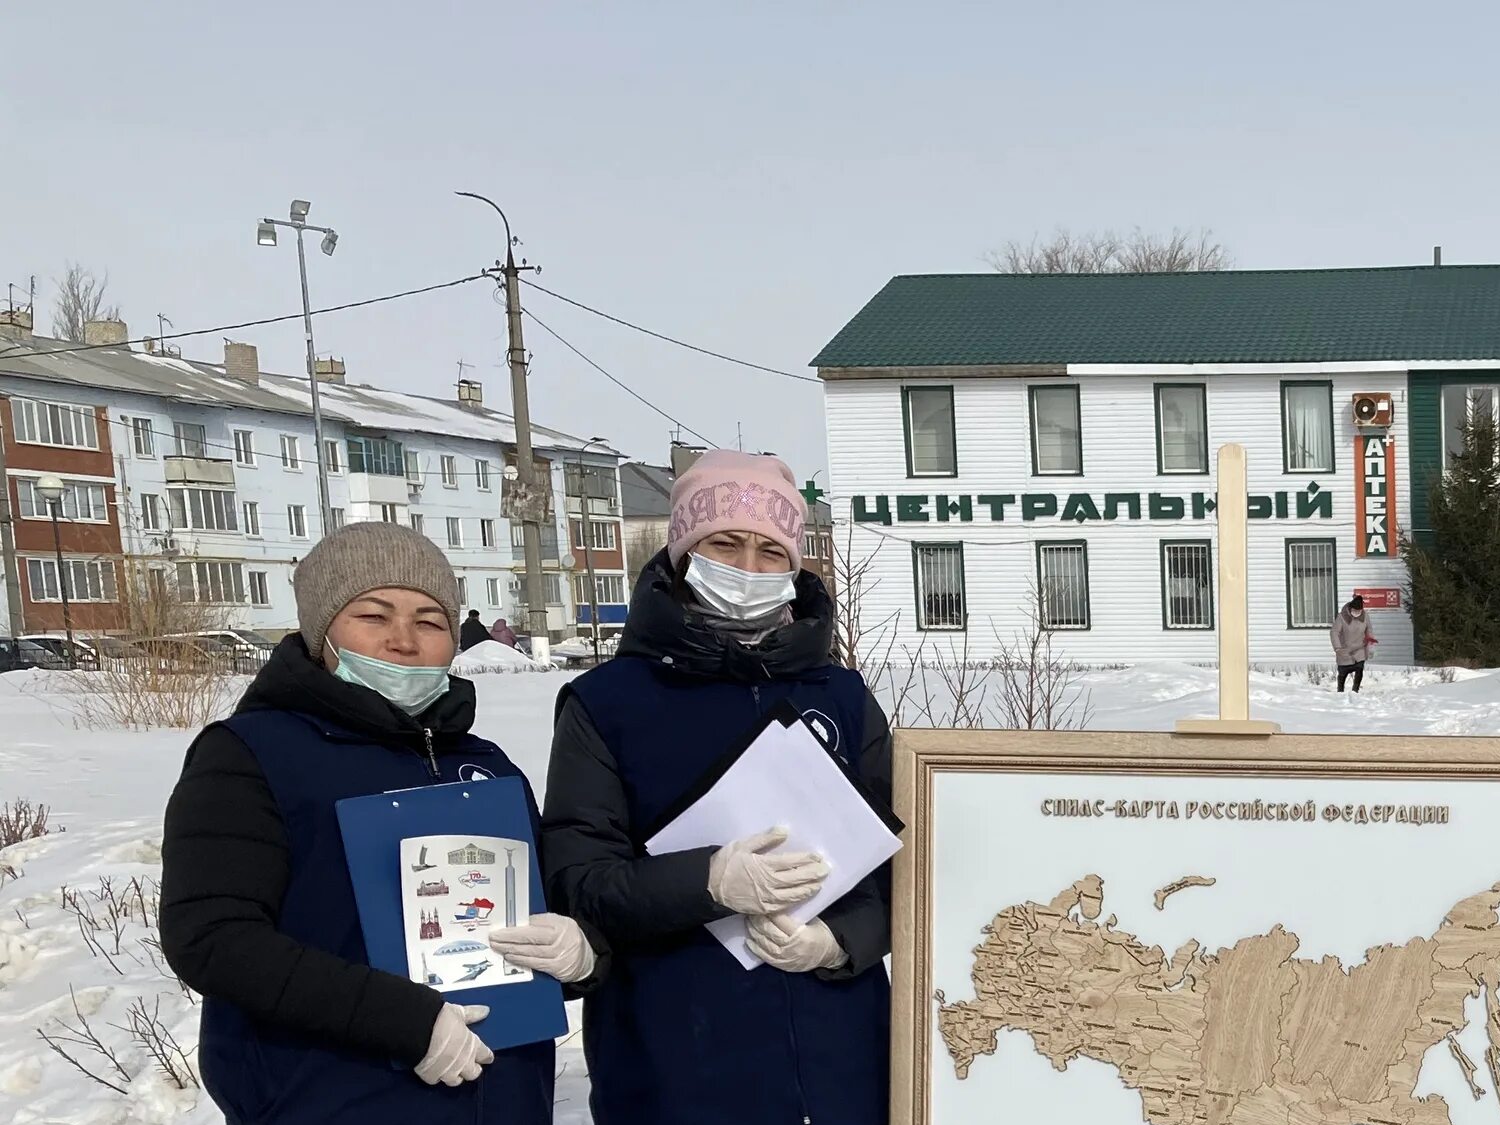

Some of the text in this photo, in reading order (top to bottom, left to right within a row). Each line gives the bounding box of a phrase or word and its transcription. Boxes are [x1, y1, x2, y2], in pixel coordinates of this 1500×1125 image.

[1364, 438, 1387, 553] АПТЕКА
[1041, 799, 1449, 826] СПИЛС-КАРТА РОССИЙСКОЙ ФЕДЕРАЦИИ
